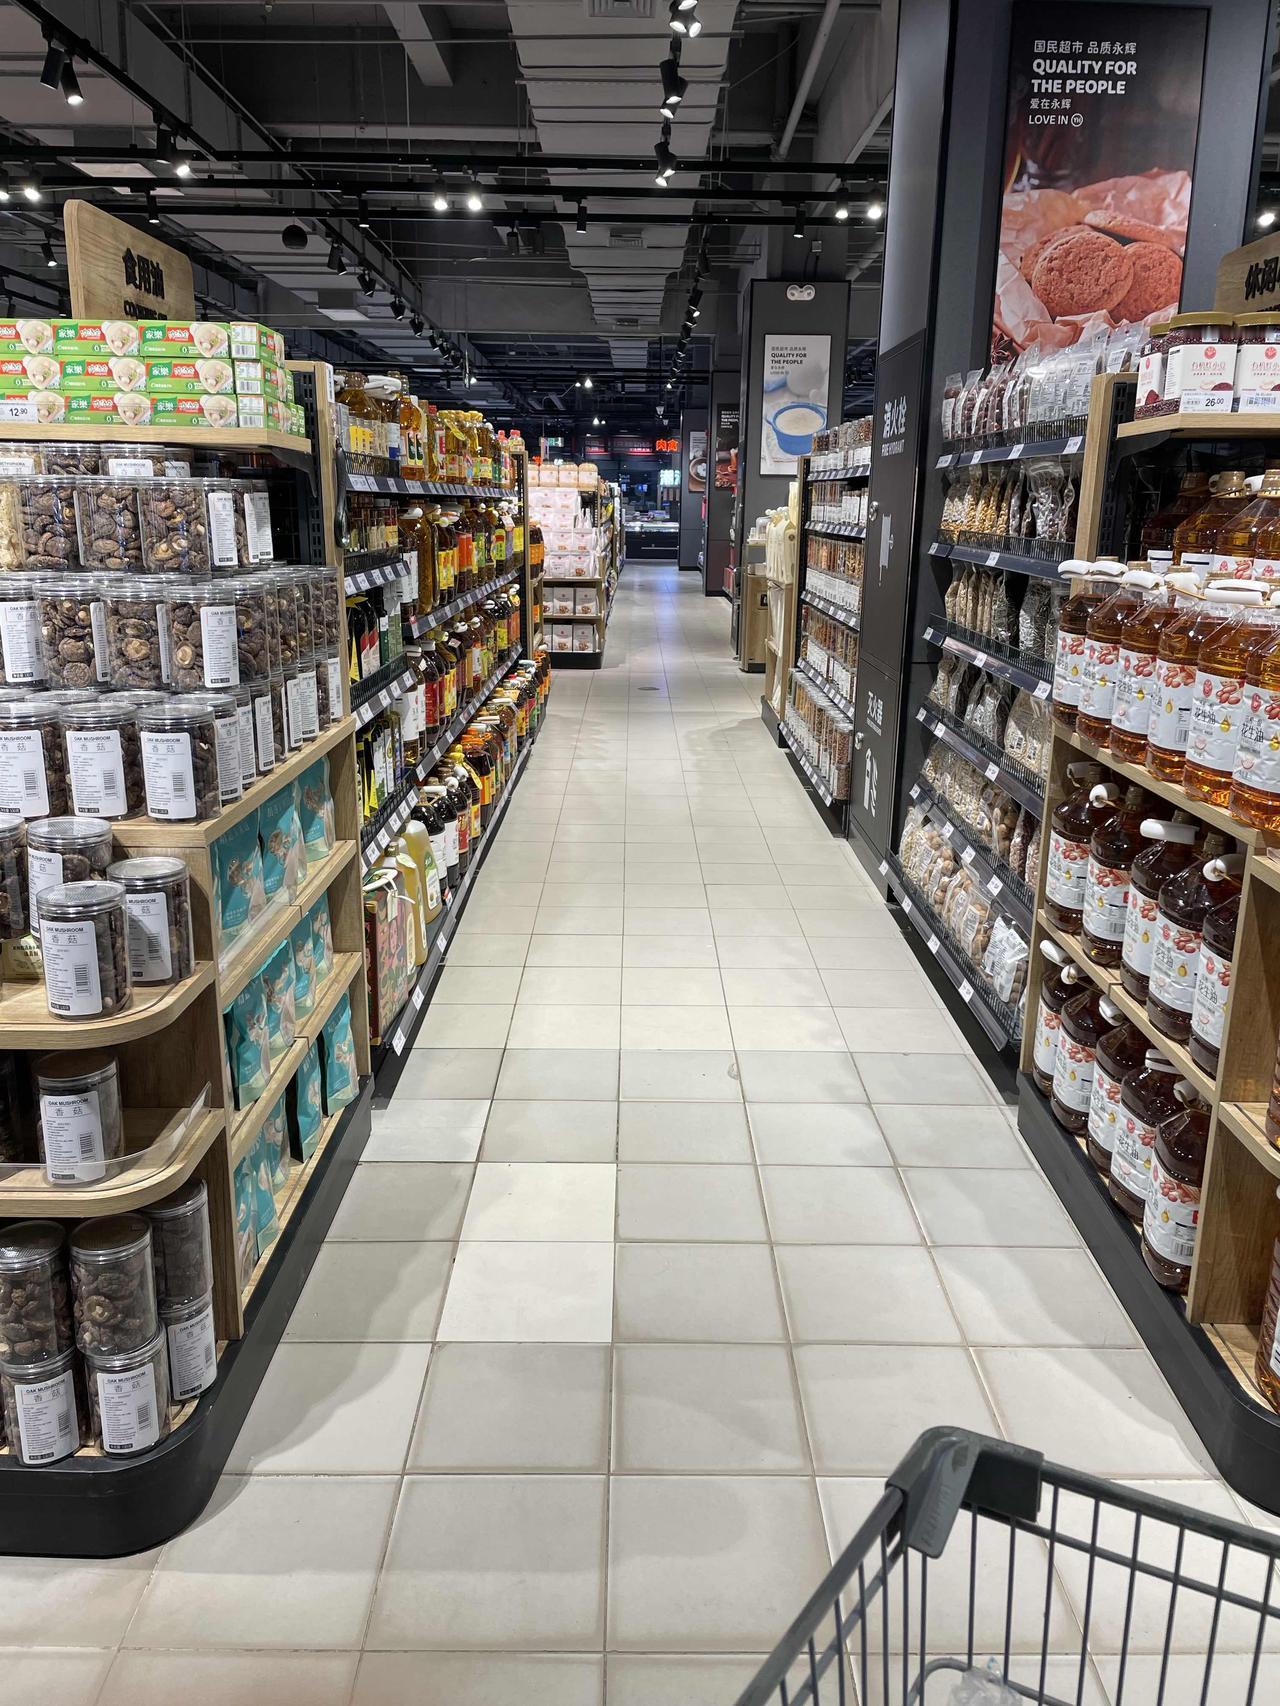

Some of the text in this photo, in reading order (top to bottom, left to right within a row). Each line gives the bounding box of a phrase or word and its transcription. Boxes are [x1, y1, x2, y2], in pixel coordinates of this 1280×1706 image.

[1034, 40, 1137, 55] 国民超市 品质永辉
[1032, 58, 1137, 75] QUALITY FOR
[1031, 79, 1126, 94] THE PEOPLE
[1030, 98, 1072, 110] 爱在永辉
[1028, 114, 1056, 125] LOVE
[1058, 115, 1068, 125] IN
[122, 247, 166, 300] 食用油
[1245, 256, 1280, 300] 休闲
[883, 396, 906, 438] 消火栓
[1194, 707, 1216, 725] 花生油
[1241, 722, 1264, 742] 花生油
[118, 1371, 146, 1382] MUSHROOM
[38, 1379, 65, 1392] MUSHROOM
